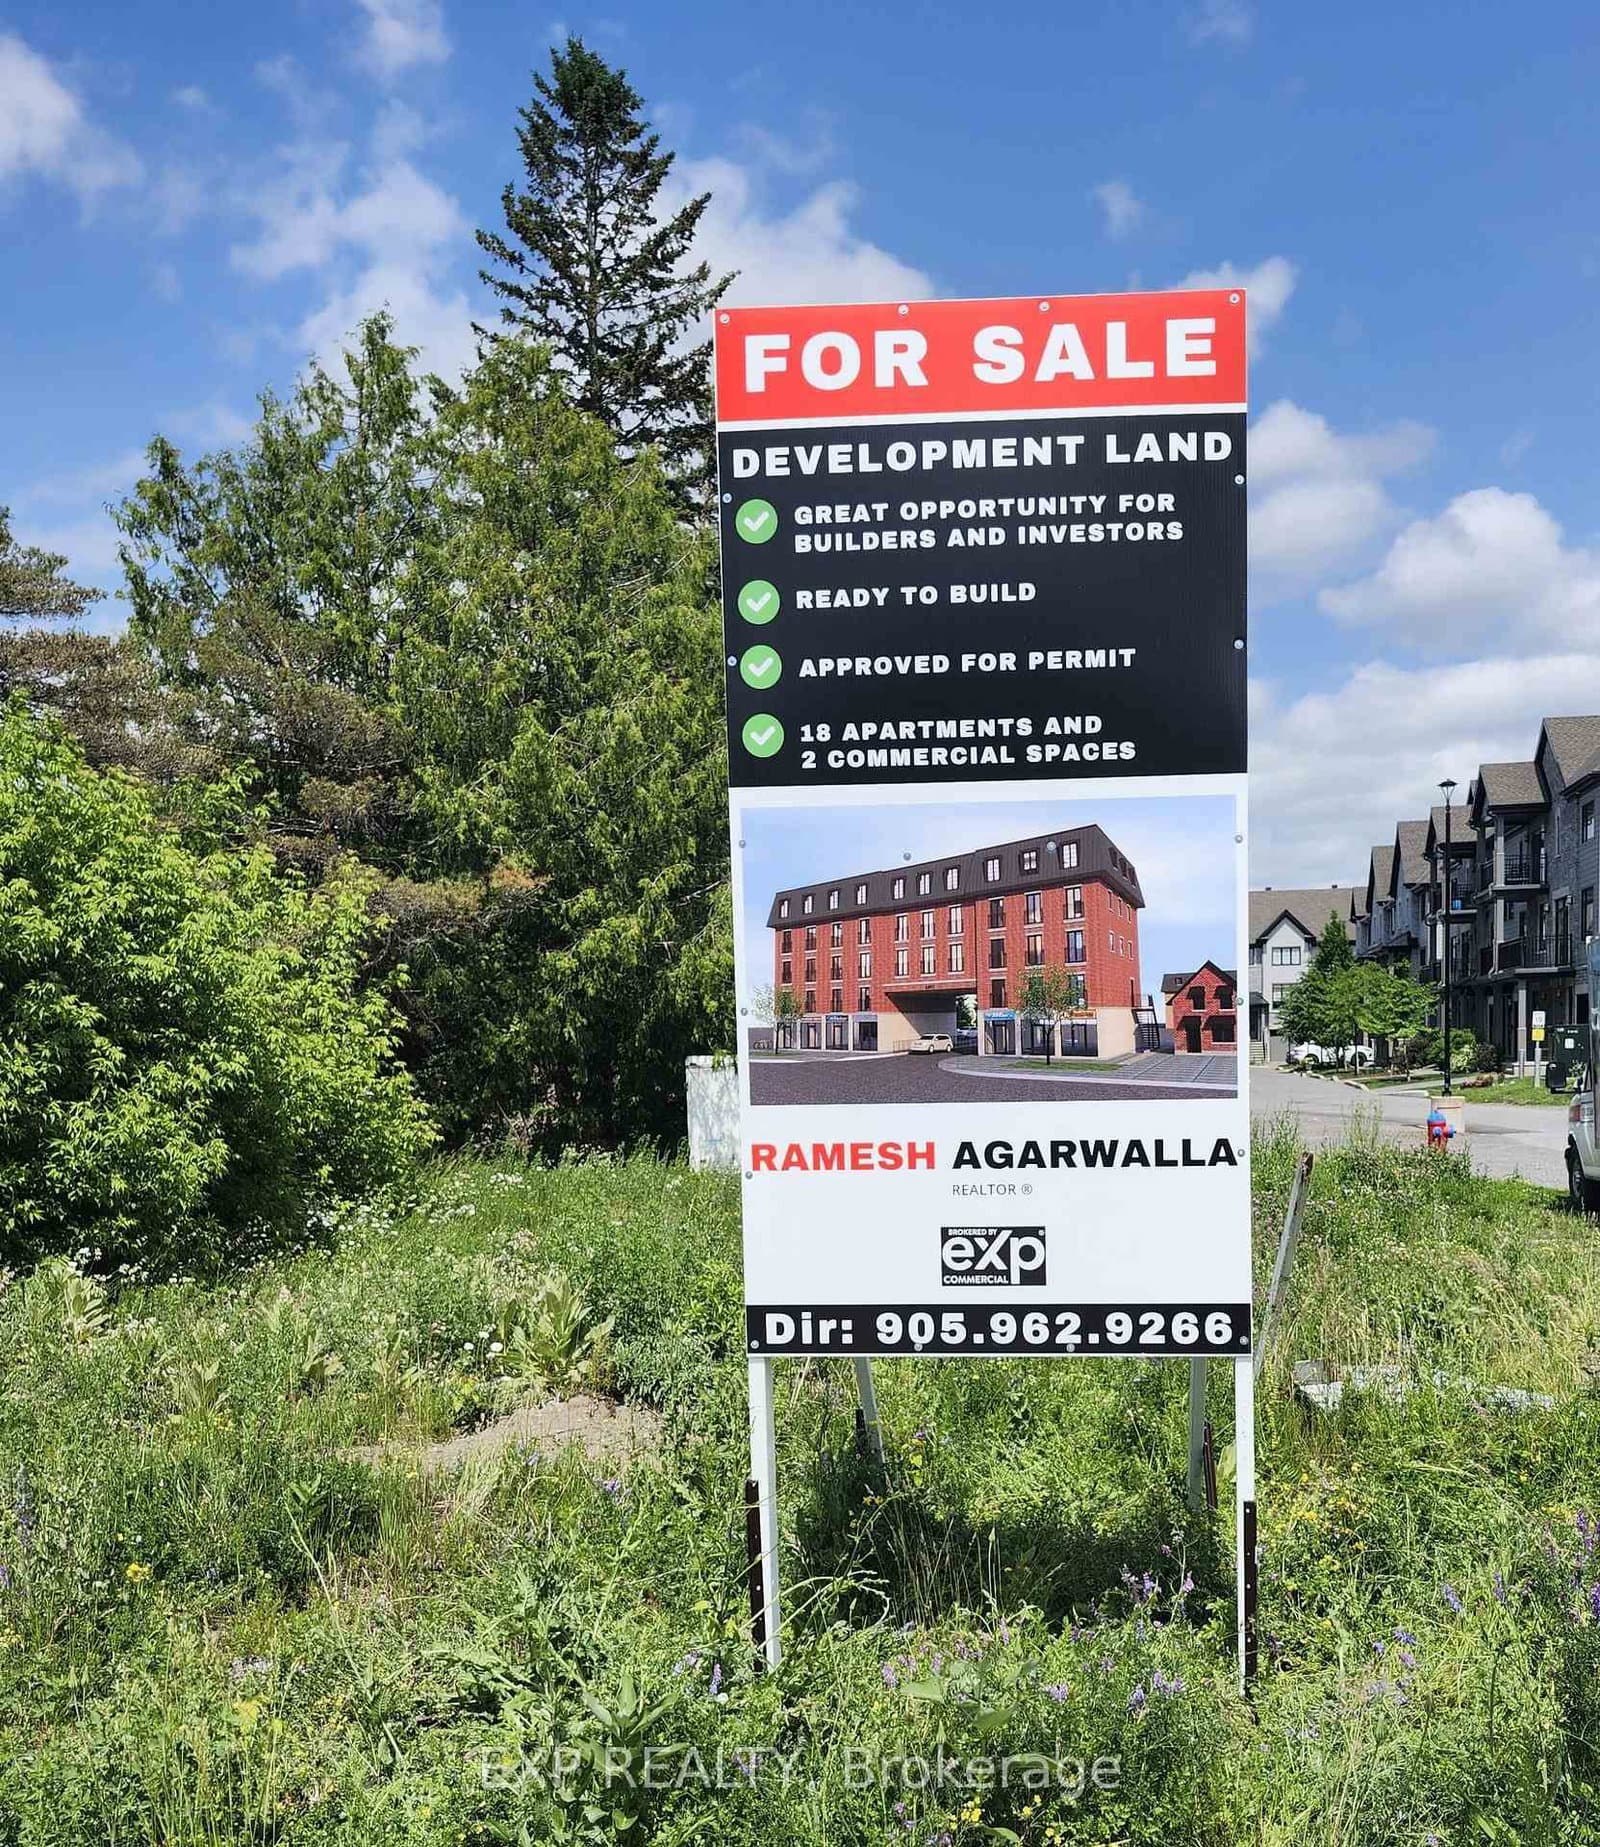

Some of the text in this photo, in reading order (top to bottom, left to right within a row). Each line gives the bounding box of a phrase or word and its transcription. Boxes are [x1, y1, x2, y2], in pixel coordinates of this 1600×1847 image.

[745, 317, 1217, 393] FOR SALE
[732, 431, 1232, 478] DEVELOPMENT LAND
[794, 493, 1175, 525] GREAT OPPORTUNITY FOR
[794, 521, 1183, 553] BUILDERS AND INVESTORS
[796, 582, 1036, 609] READY TO BUILD
[799, 648, 1136, 678] APPROVED FOR PERMIT
[800, 715, 1102, 742] 18 APARTMENTS AND
[801, 741, 1136, 769] 2 COMMERCIAL SPACES
[751, 1138, 1238, 1172] RAMESH AGARWALLA
[952, 1183, 1017, 1196] REALTOR
[948, 1228, 998, 1237] BROKERED BY
[943, 1275, 1009, 1284] COMMERCIAL
[765, 1311, 1233, 1346] Dir: 905.962.9266
